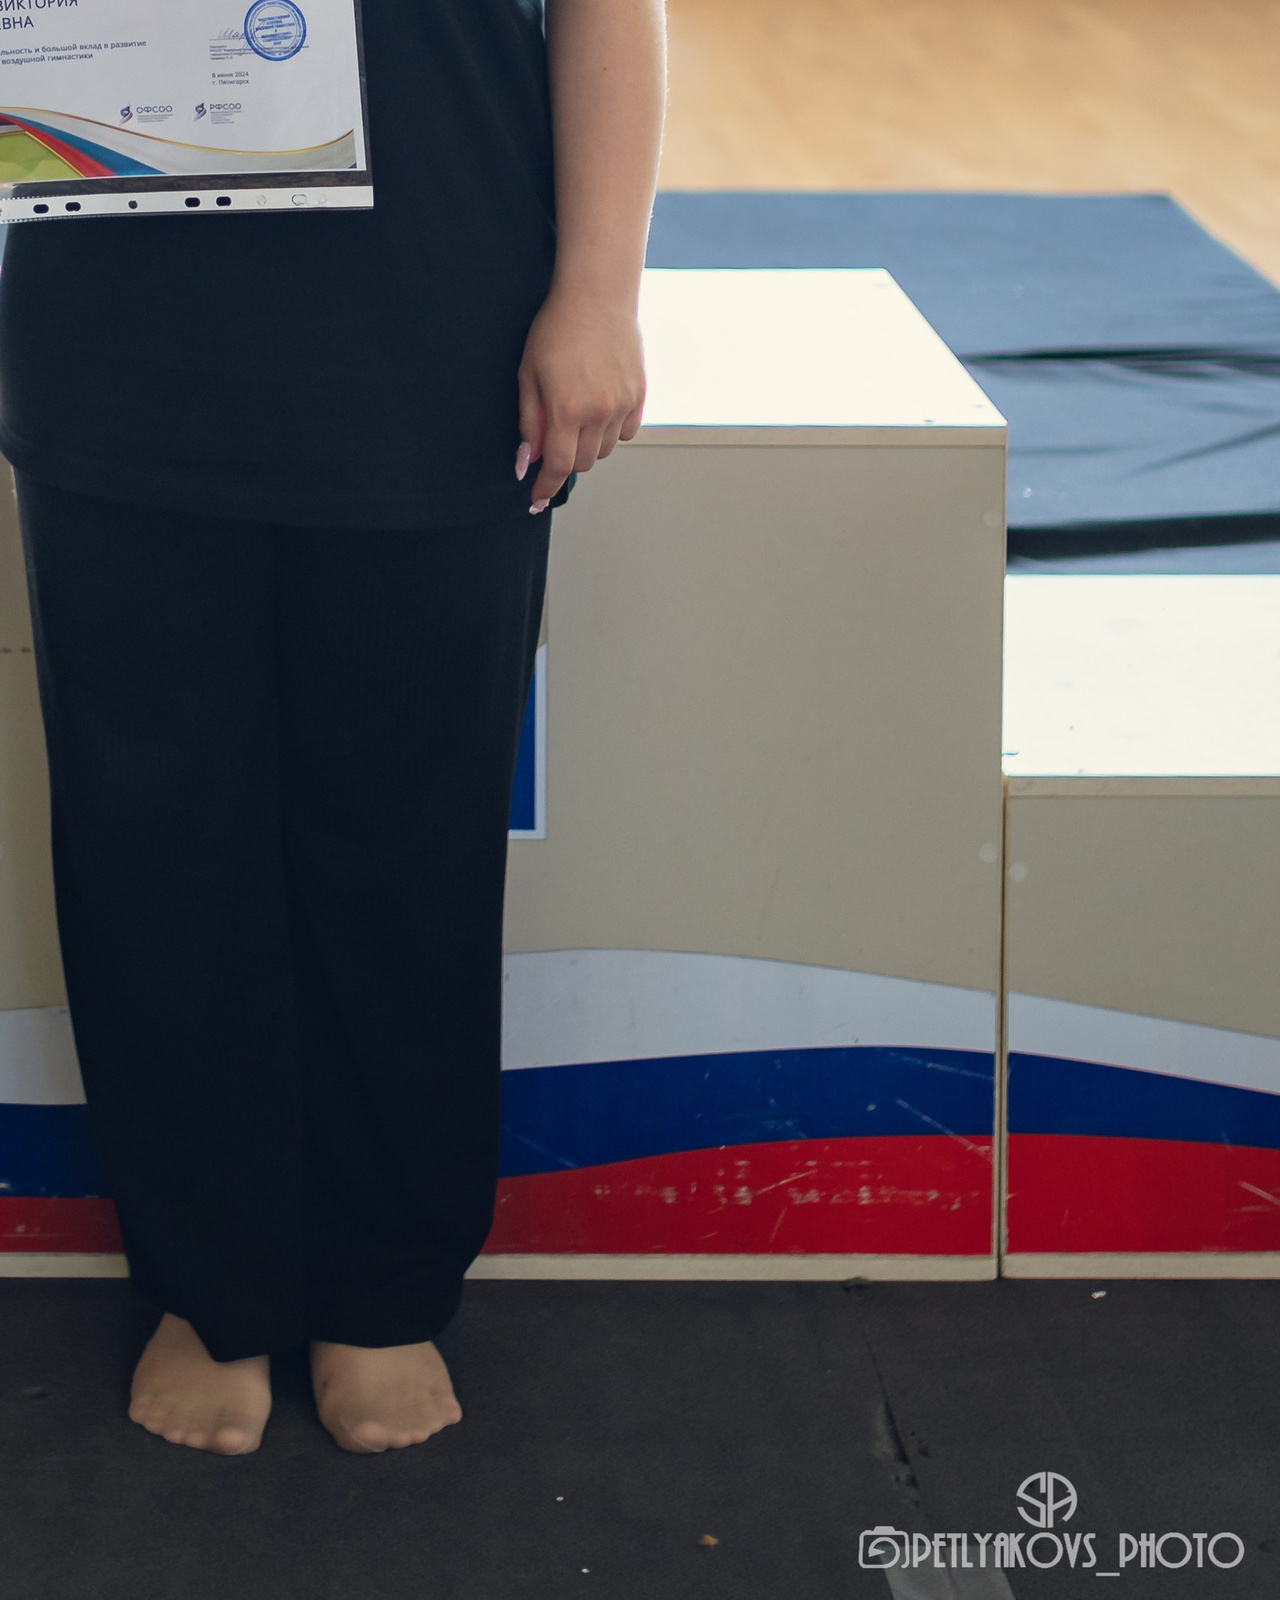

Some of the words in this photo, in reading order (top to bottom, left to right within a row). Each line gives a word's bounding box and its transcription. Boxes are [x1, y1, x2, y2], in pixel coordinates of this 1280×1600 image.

[41, 43, 78, 53] большой
[110, 40, 147, 50] развитие
[1, 55, 46, 66] воздушной
[47, 53, 94, 62] гимнастики
[136, 105, 173, 114] ОФСОО
[209, 103, 242, 111] РФСОО
